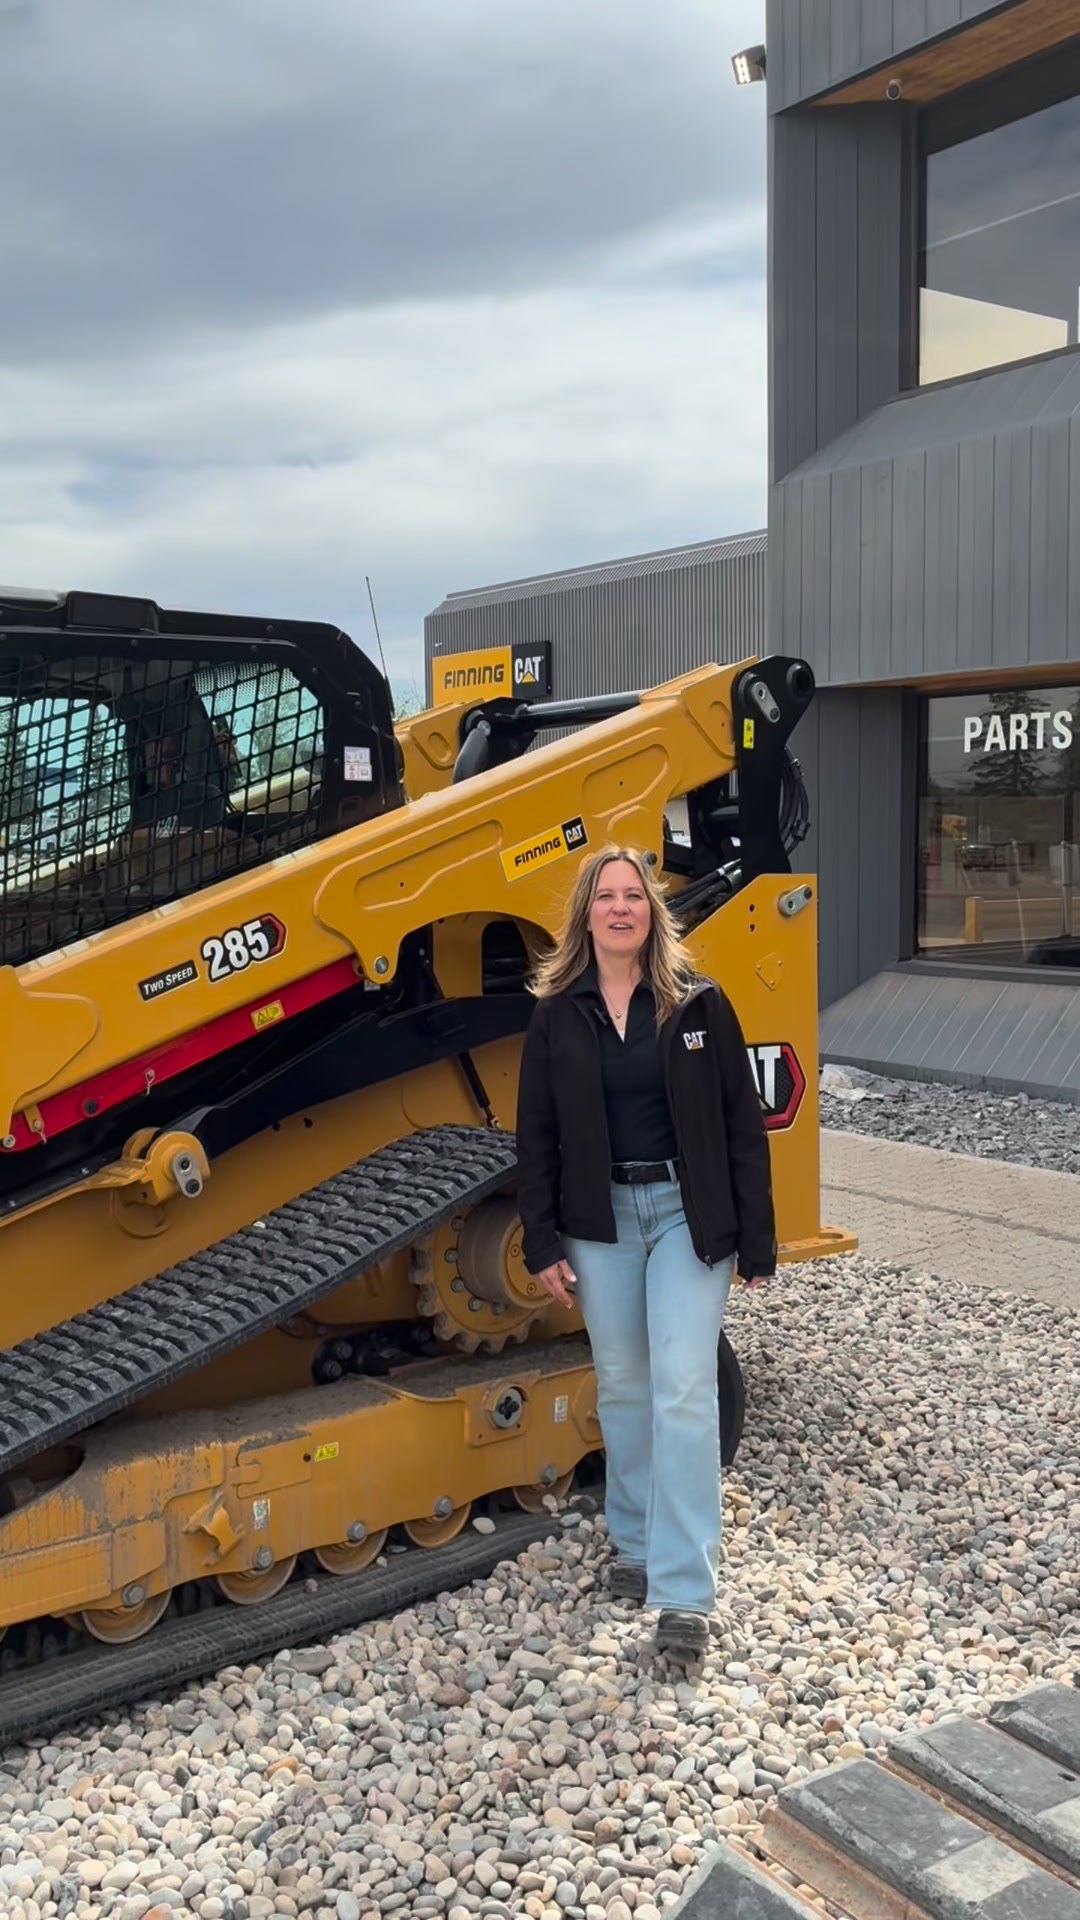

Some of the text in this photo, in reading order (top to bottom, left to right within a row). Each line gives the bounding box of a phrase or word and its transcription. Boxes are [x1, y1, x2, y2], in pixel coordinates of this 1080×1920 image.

[444, 656, 542, 689] FINNING CAT
[964, 710, 1073, 753] PARTS
[514, 824, 583, 867] FINNING CAT
[202, 920, 270, 980] 285
[143, 967, 193, 995] TWO SPEED
[683, 1031, 705, 1051] CAT
